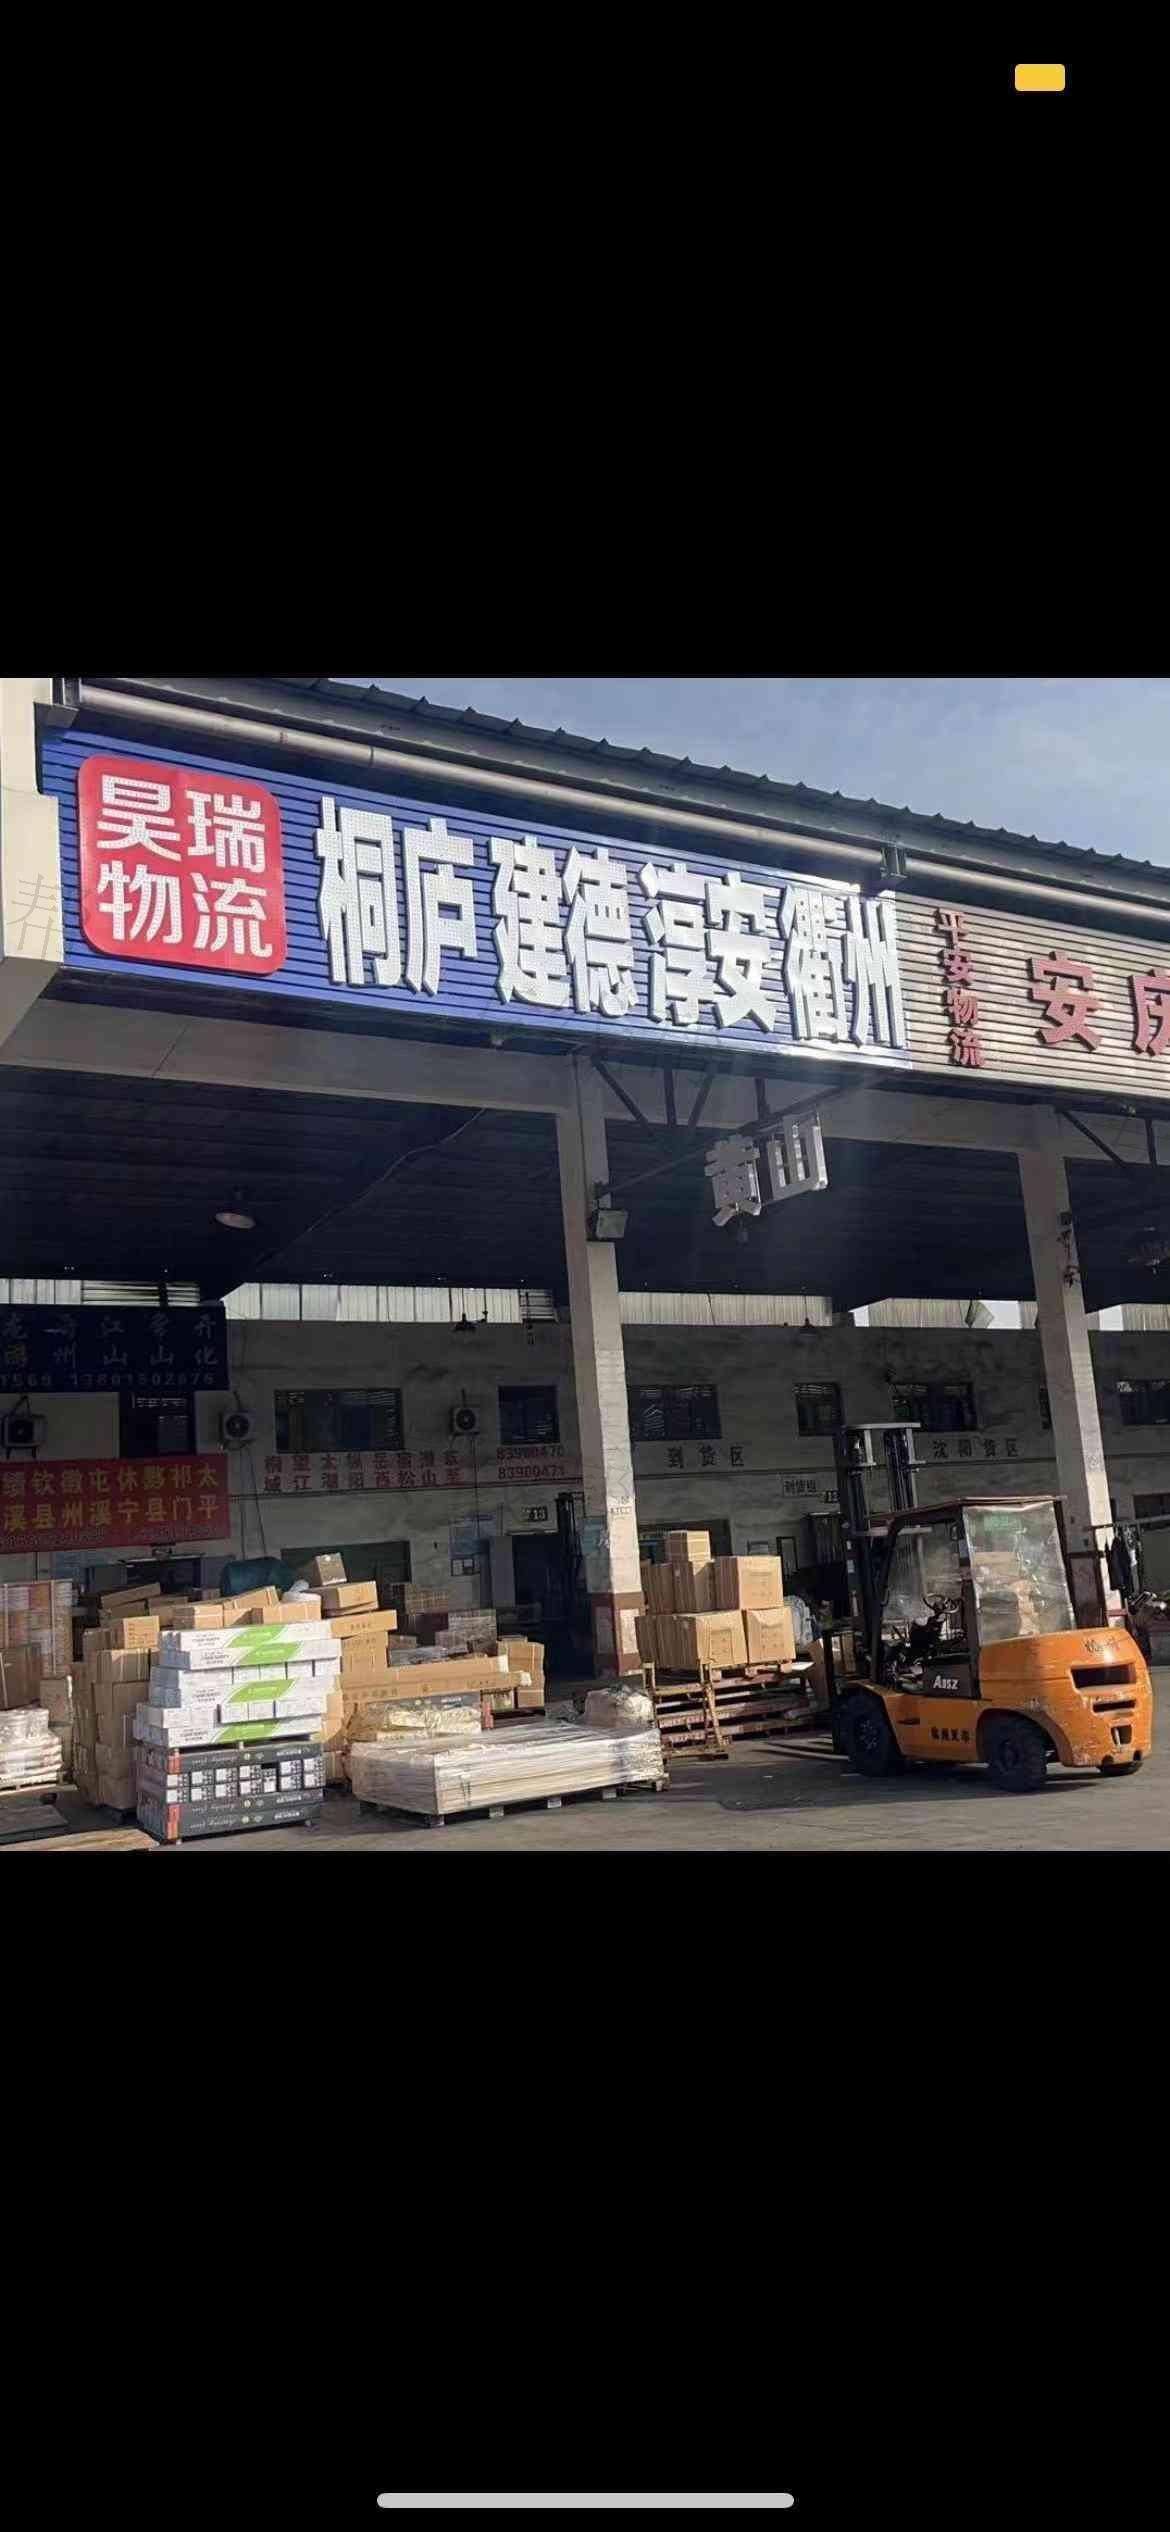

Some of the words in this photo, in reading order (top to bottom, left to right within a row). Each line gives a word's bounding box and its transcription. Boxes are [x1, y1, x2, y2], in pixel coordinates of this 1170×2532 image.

[97, 774, 266, 874] 昊瑞
[97, 861, 272, 958] 物流
[314, 796, 903, 1048] 桐庐建德淳安衢州
[936, 908, 985, 1068] 平安物流
[704, 1108, 828, 1226] 黄山
